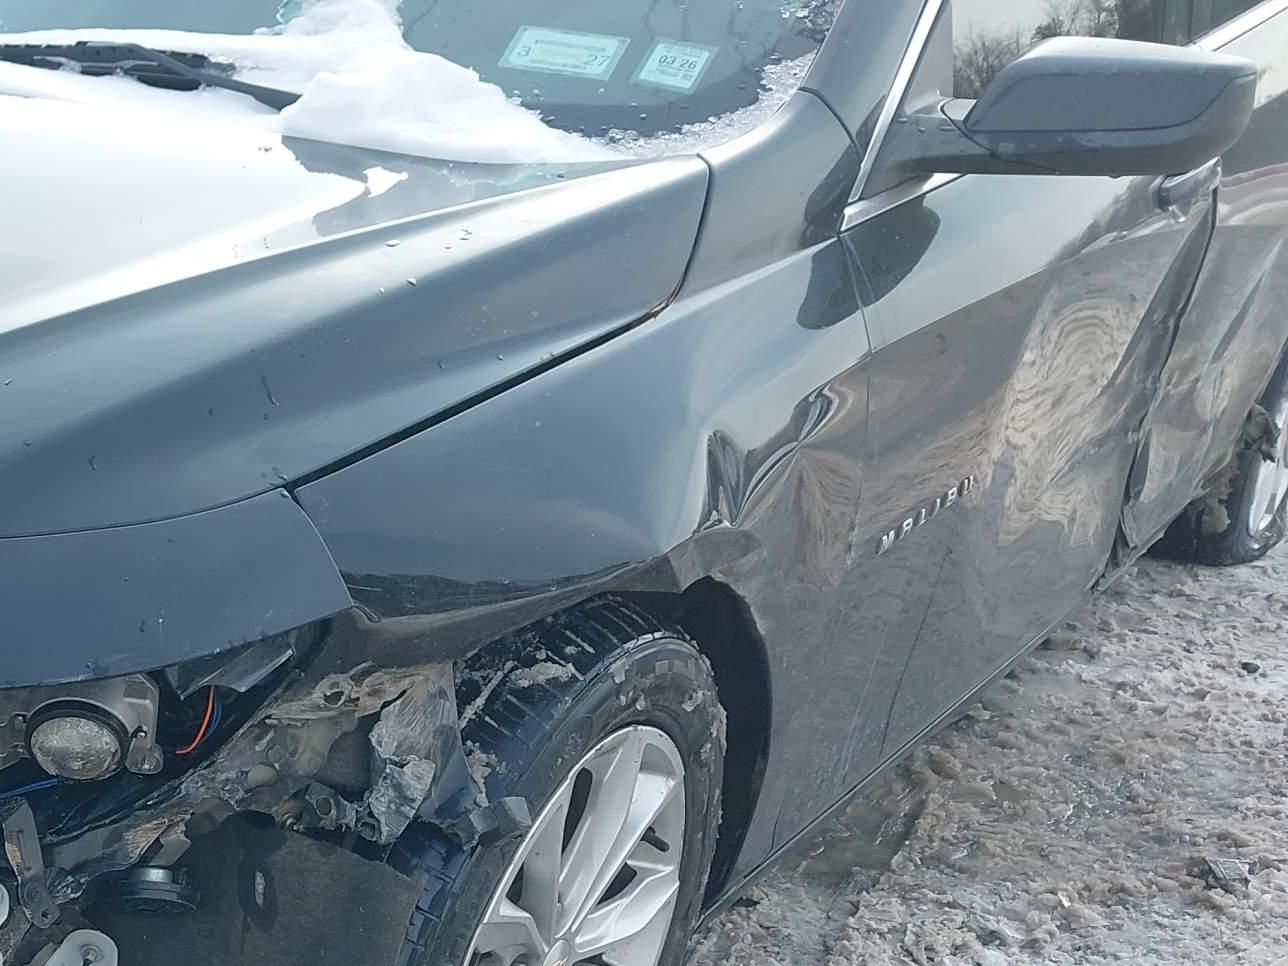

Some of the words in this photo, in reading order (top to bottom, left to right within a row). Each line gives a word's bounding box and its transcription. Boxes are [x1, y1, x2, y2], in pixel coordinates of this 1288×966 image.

[658, 54, 677, 65] 03
[679, 58, 698, 70] 26
[877, 475, 974, 556] MALIBU
